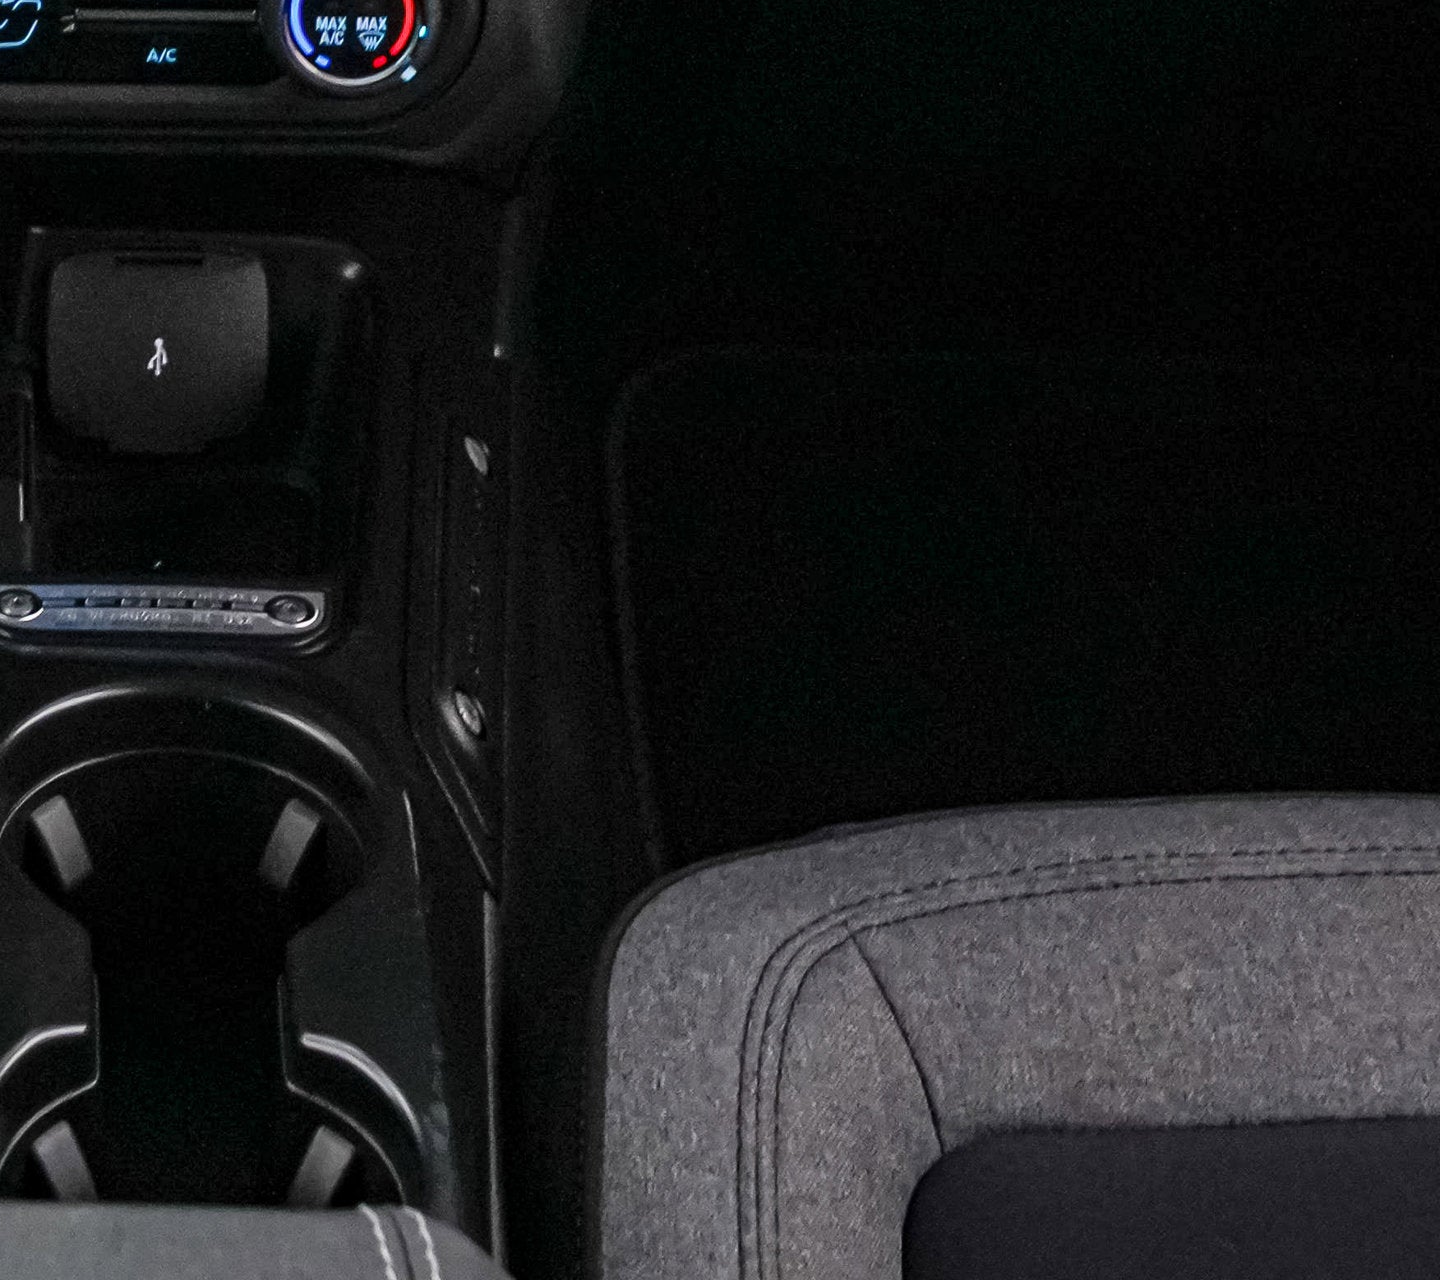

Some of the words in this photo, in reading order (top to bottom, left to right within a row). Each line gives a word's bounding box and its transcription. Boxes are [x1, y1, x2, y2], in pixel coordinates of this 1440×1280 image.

[315, 17, 347, 31] MAX
[356, 17, 388, 31] MAX
[319, 31, 345, 47] A/C
[146, 47, 177, 63] A/C
